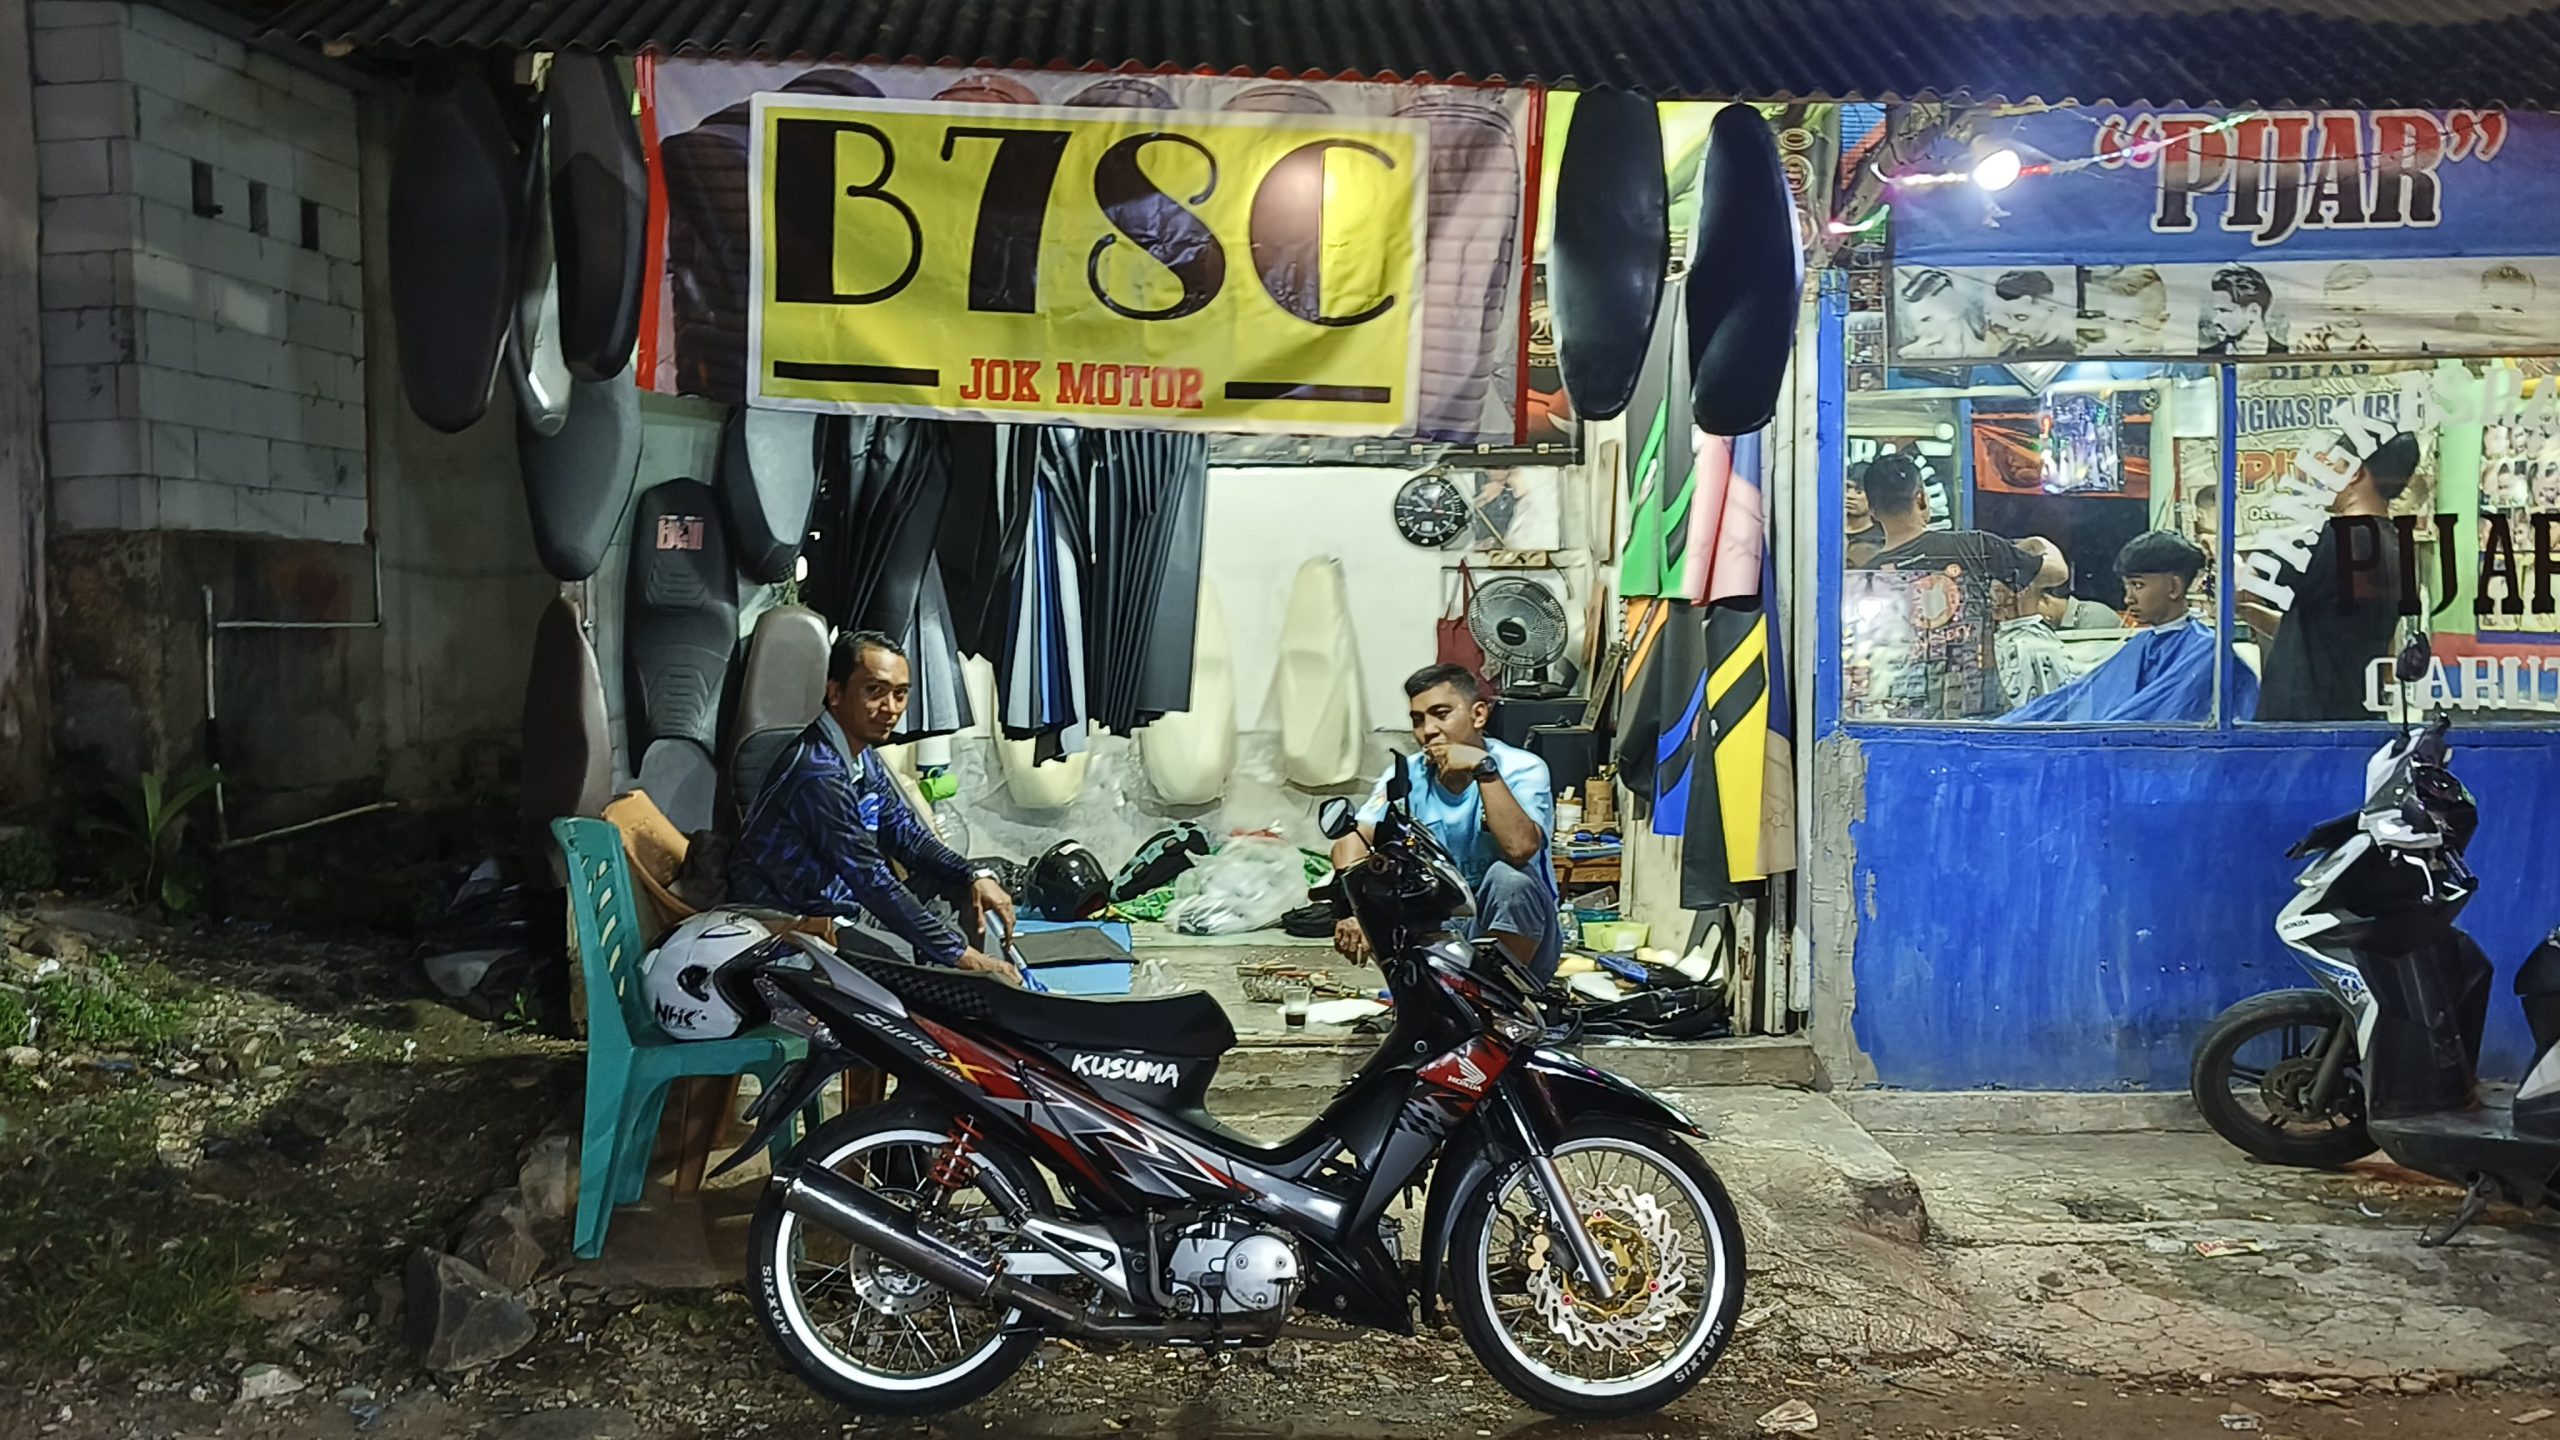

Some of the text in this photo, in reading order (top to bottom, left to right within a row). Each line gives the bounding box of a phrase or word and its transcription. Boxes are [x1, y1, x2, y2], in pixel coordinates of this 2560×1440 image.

[960, 358, 1203, 409] JOK MOTOR
[1071, 1053, 1180, 1088] KUSUMA
[1446, 1074, 1483, 1092] HONDA
[762, 1264, 792, 1335] MAXXIS
[1674, 1319, 1724, 1383] MAXXIS
